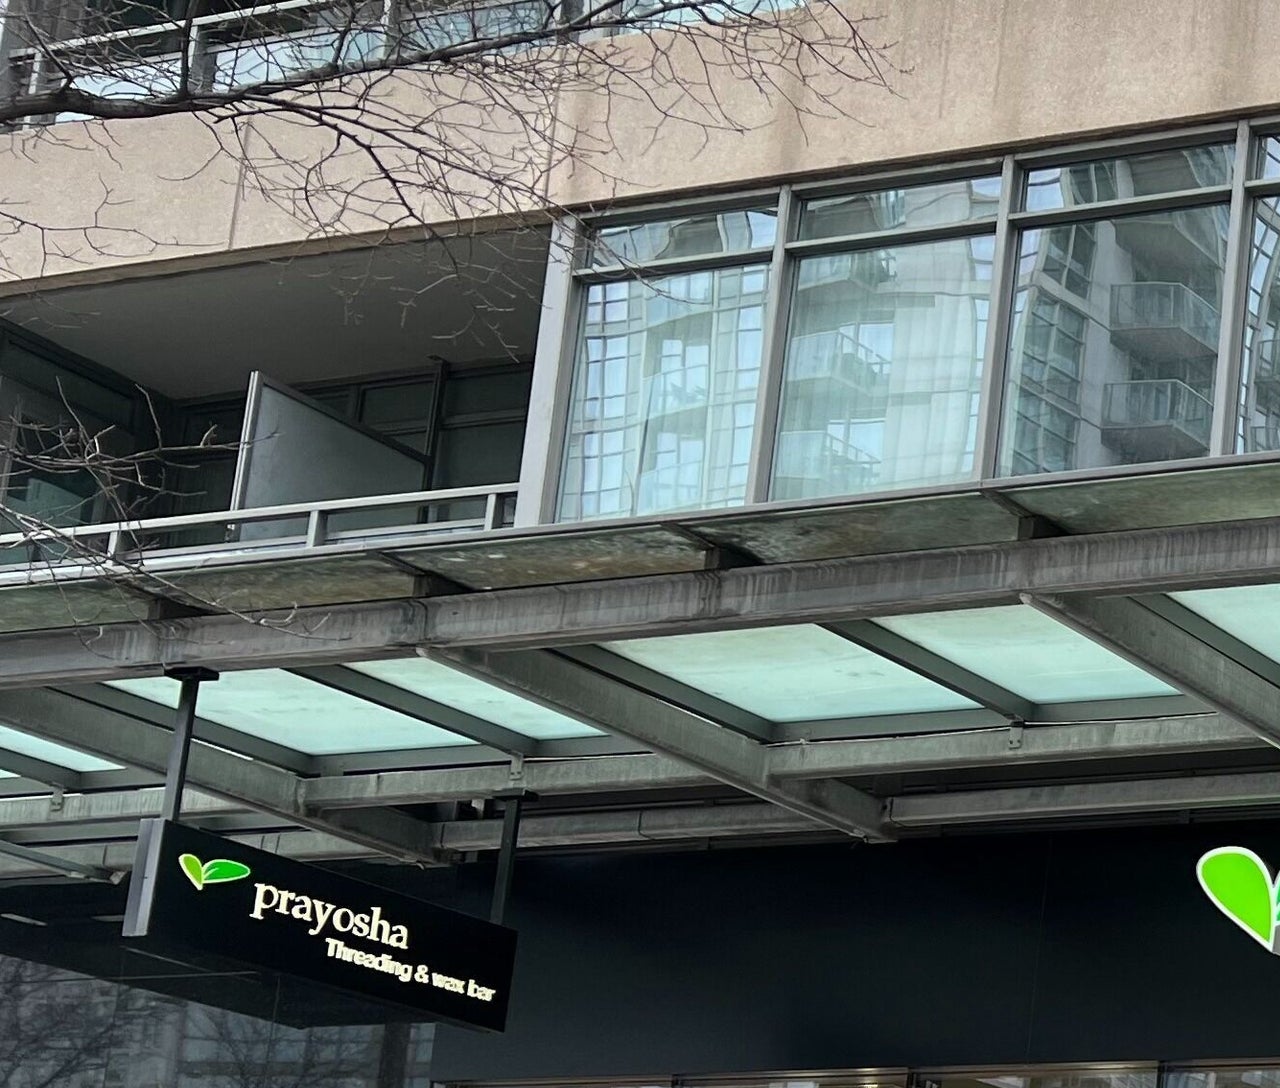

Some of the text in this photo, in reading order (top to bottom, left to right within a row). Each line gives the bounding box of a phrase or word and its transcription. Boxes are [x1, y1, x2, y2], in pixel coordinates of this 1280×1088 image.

[249, 883, 408, 949] prayosha
[325, 938, 496, 1002] Threading & wax bar
